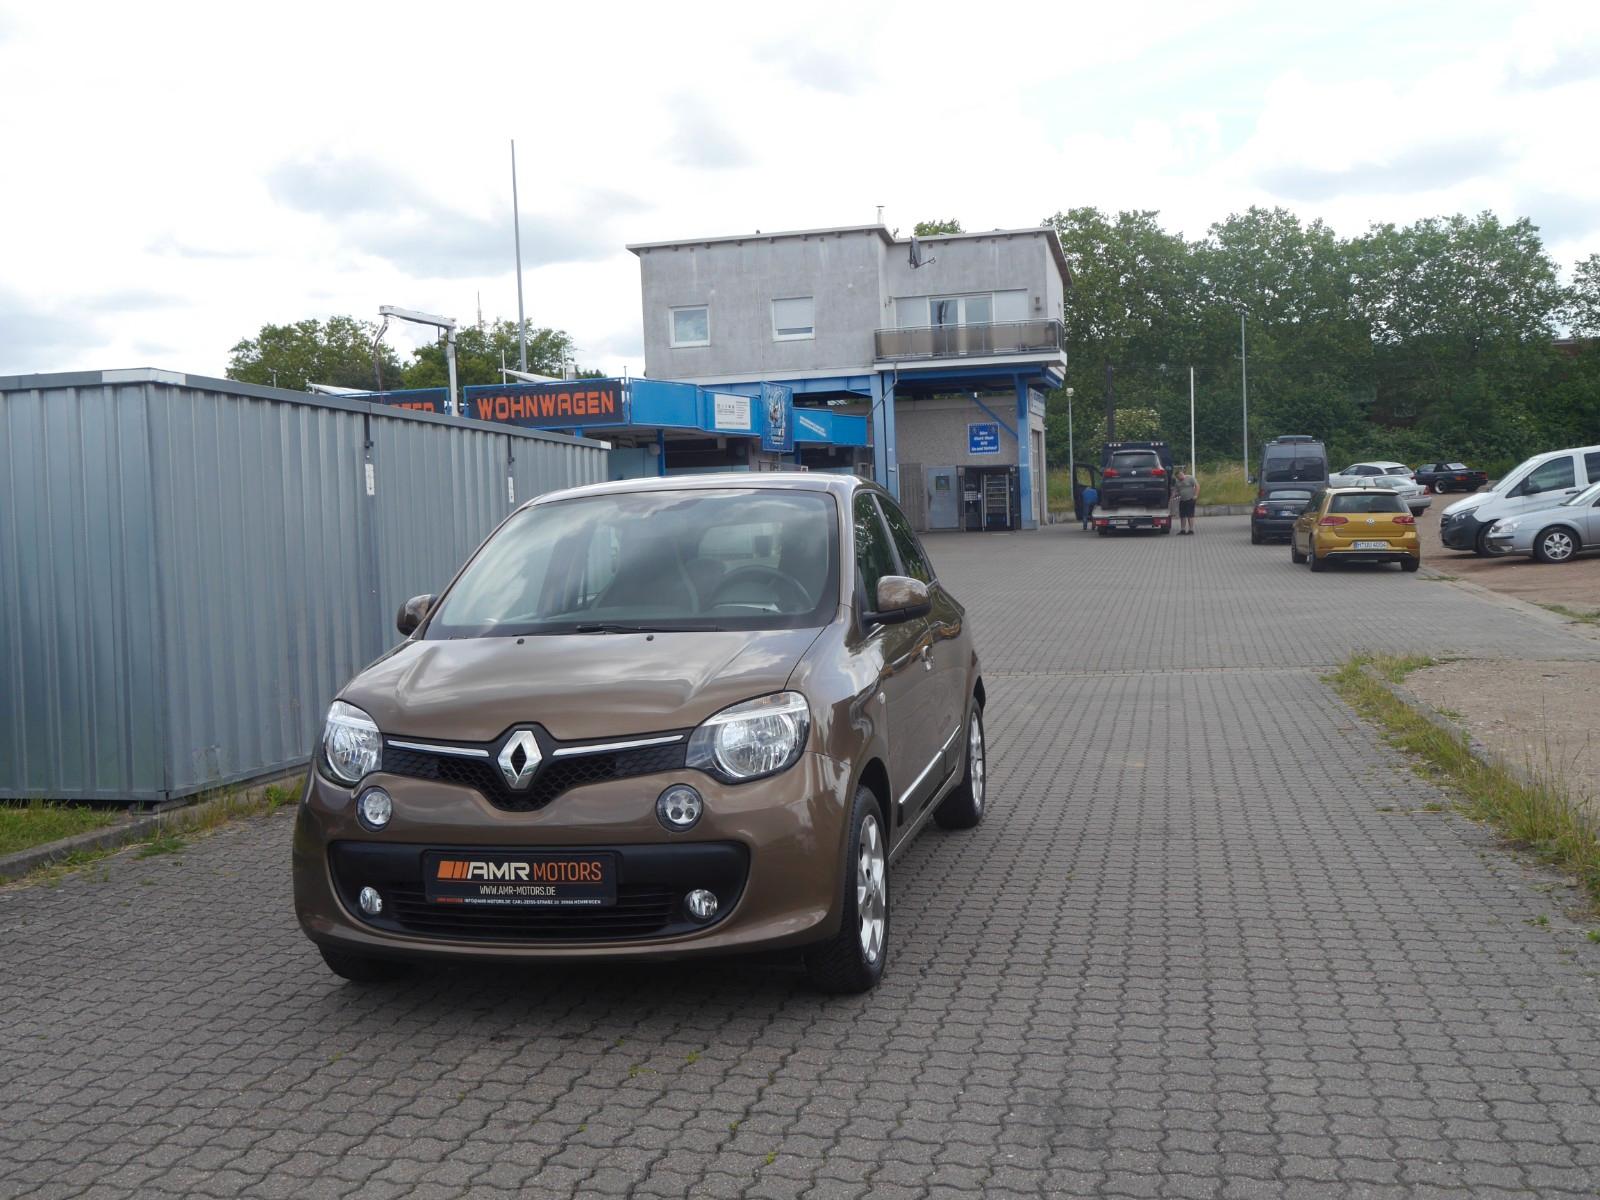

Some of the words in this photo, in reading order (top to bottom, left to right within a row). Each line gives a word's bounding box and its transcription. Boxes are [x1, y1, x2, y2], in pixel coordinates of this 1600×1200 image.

[477, 390, 614, 420] WOHNWAGEN
[467, 861, 529, 880] AMR
[534, 861, 602, 881] MOTORS
[479, 885, 556, 896] WWW.AMR-MOTORS.DE
